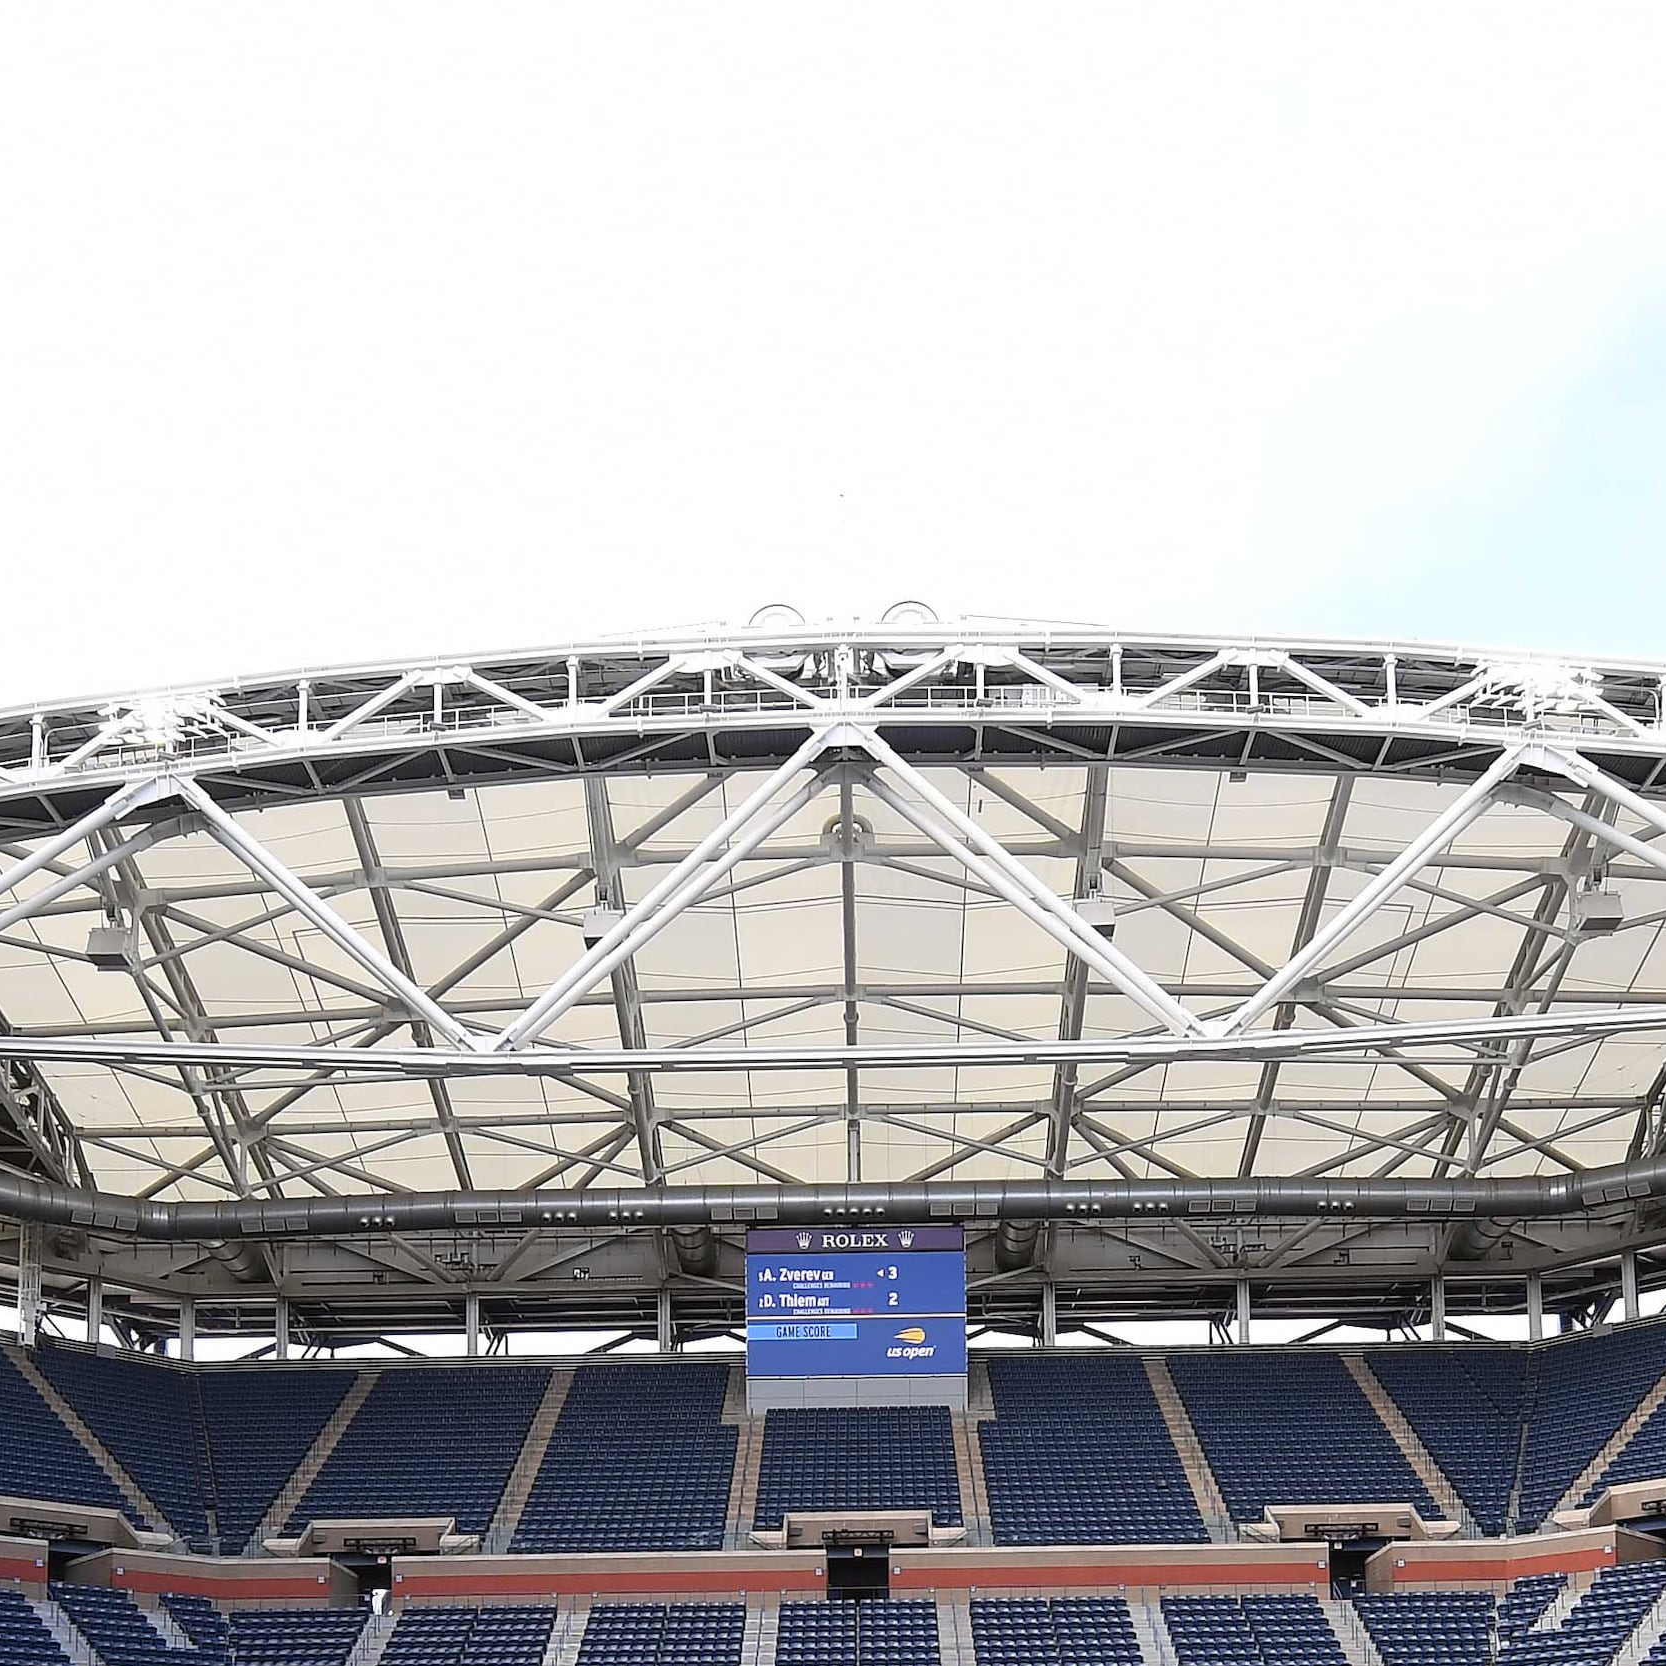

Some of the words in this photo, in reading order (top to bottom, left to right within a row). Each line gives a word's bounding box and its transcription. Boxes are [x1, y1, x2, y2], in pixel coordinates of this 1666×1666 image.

[822, 1233, 888, 1248] ROLEX
[764, 1269, 776, 1282] A.
[780, 1267, 820, 1281] Zverev
[888, 1267, 897, 1279] 3
[765, 1295, 776, 1308] D.
[779, 1293, 815, 1308] Thiem
[889, 1293, 898, 1305] 2
[776, 1327, 801, 1337] GAME
[804, 1326, 832, 1337] SCORE
